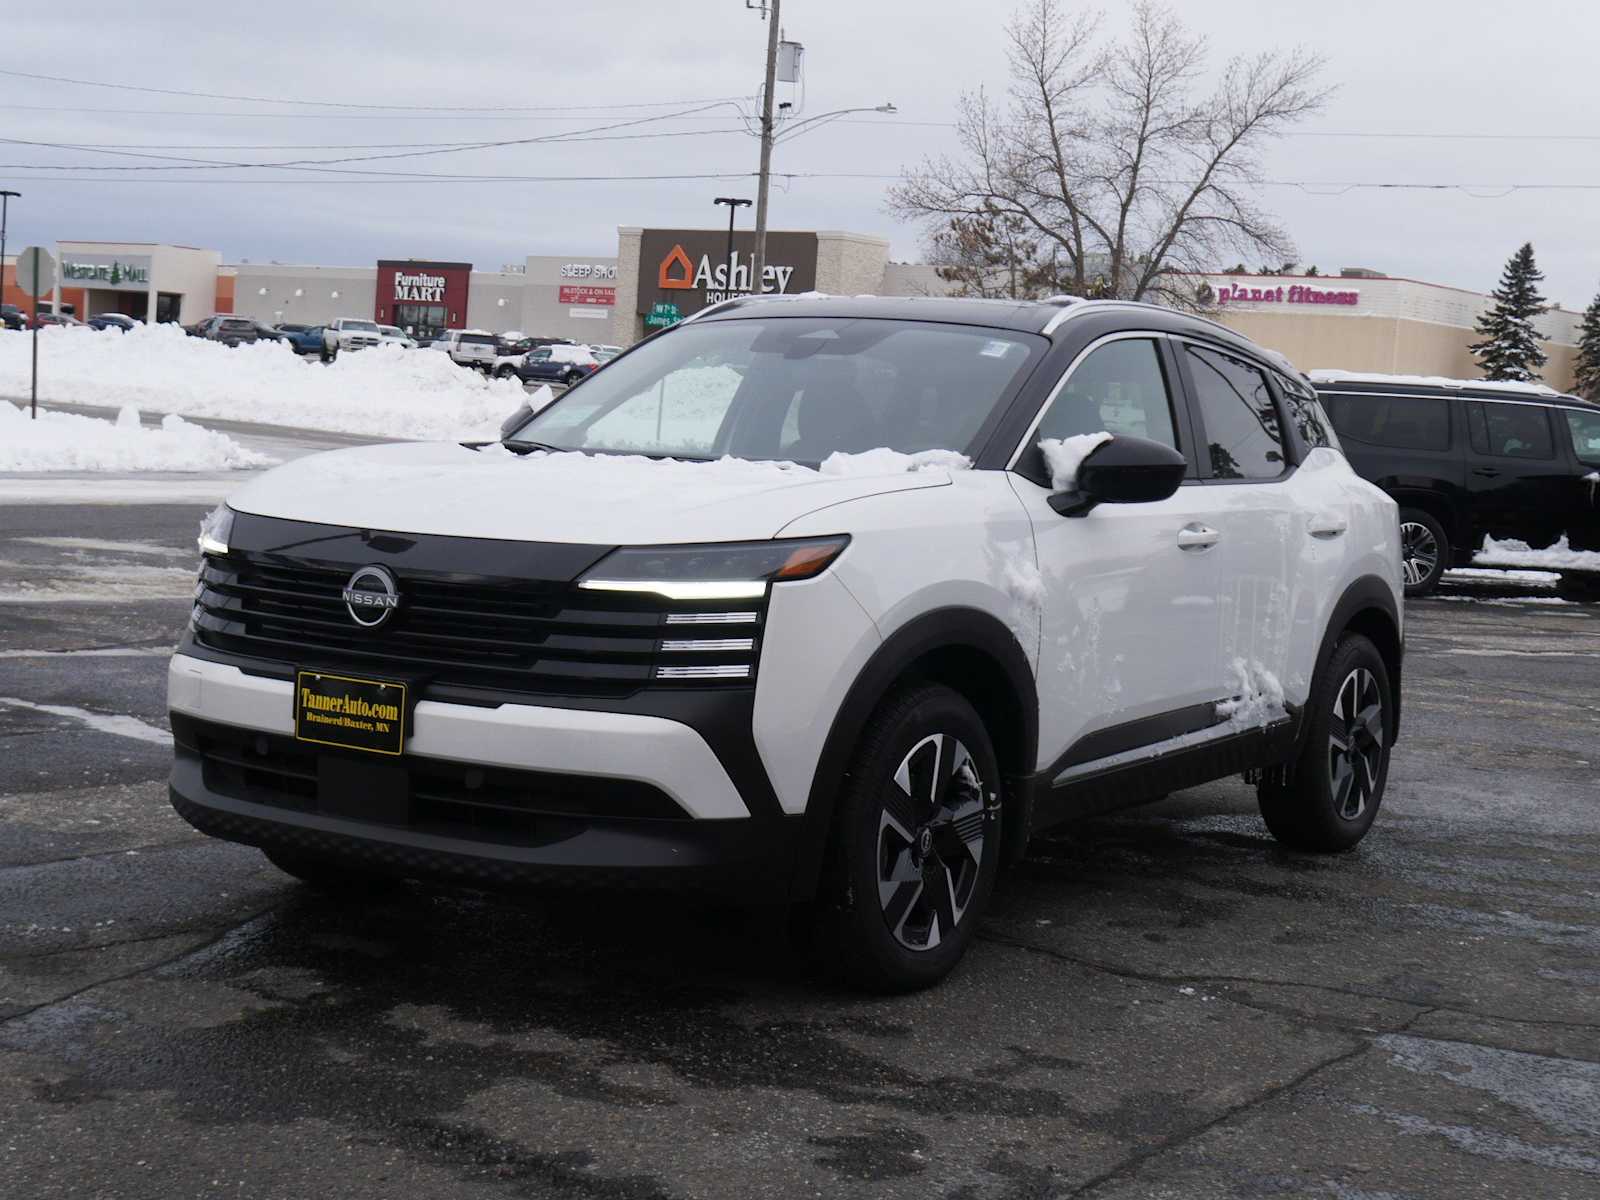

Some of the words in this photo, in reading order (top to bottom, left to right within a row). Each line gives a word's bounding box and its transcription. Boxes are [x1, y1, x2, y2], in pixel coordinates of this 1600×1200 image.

[394, 271, 446, 287] Furniture
[560, 264, 591, 278] SLEEP
[594, 264, 617, 279] SHO
[394, 286, 444, 302] MART
[1217, 283, 1284, 305] planet
[1287, 285, 1360, 305] fitness
[342, 591, 398, 607] NISSAN
[301, 687, 398, 721] TannerAuto.com
[375, 721, 390, 733] MN
